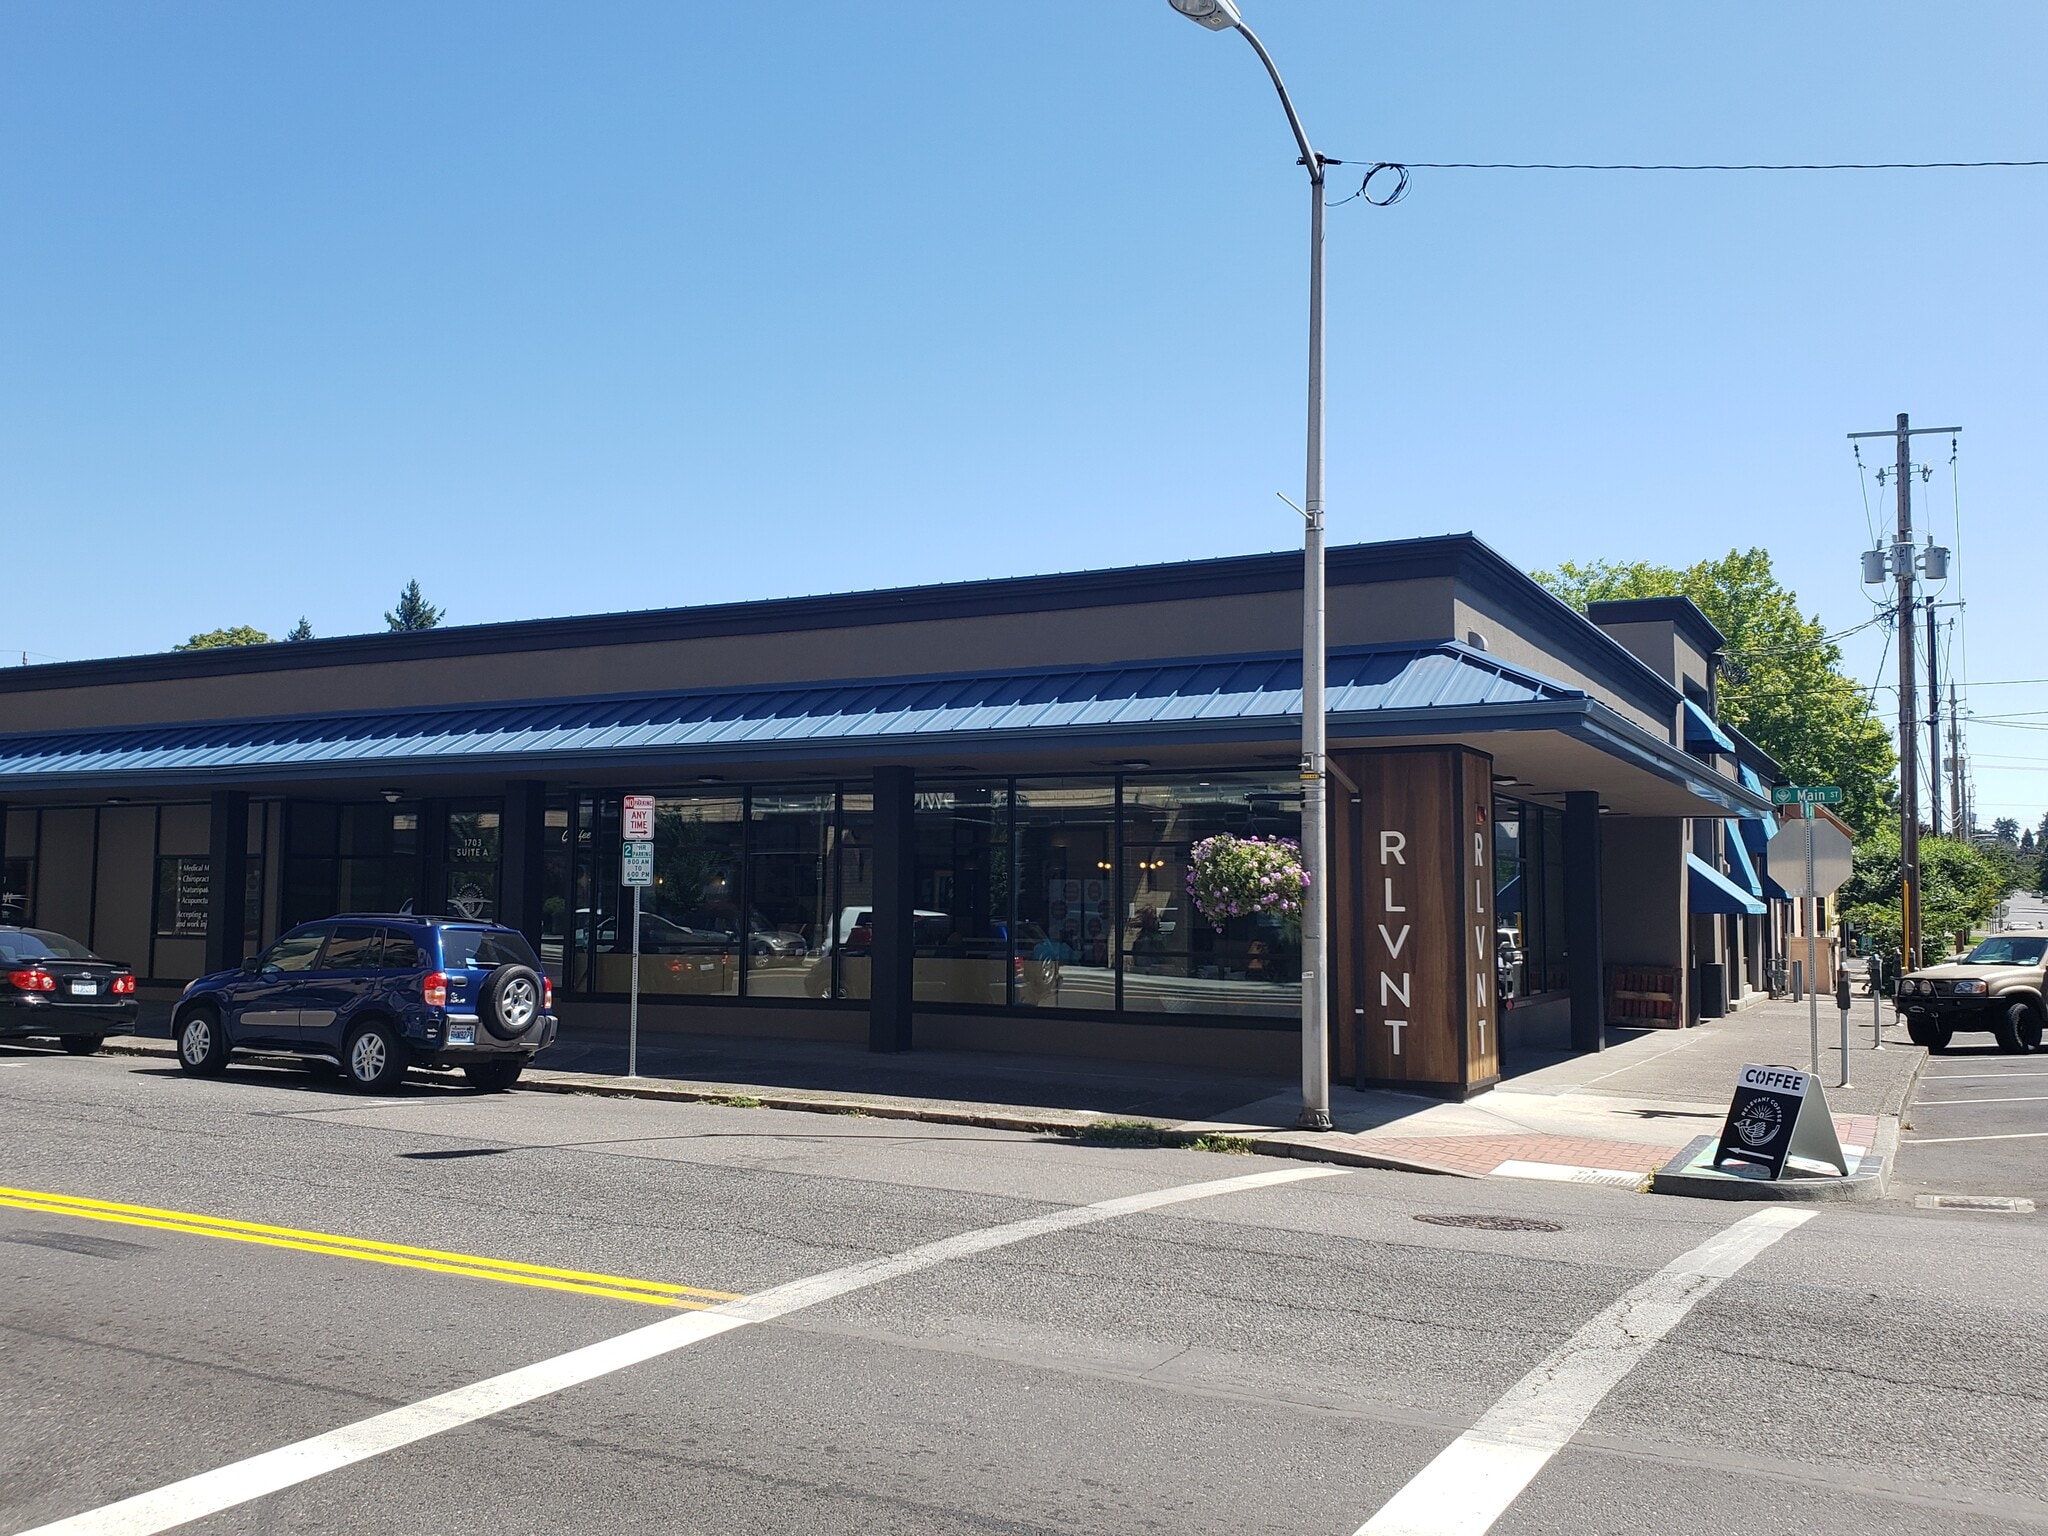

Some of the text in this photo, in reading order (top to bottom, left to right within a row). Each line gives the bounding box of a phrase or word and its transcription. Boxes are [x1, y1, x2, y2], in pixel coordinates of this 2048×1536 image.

[1797, 789, 1825, 801] Main
[625, 799, 634, 808] NO
[631, 811, 647, 820] ANY
[630, 820, 648, 829] TIME
[464, 838, 482, 847] 1703
[456, 848, 489, 857] SUITE A
[624, 844, 632, 856] 2
[183, 864, 203, 872] Medical
[175, 920, 186, 928] and
[186, 920, 200, 928] work
[1378, 830, 1410, 1055] RLVNT
[1474, 832, 1487, 1055] RLVNT
[1745, 1069, 1803, 1091] COFFEE
[1741, 1097, 1782, 1123] RELEVANT COFFEE
